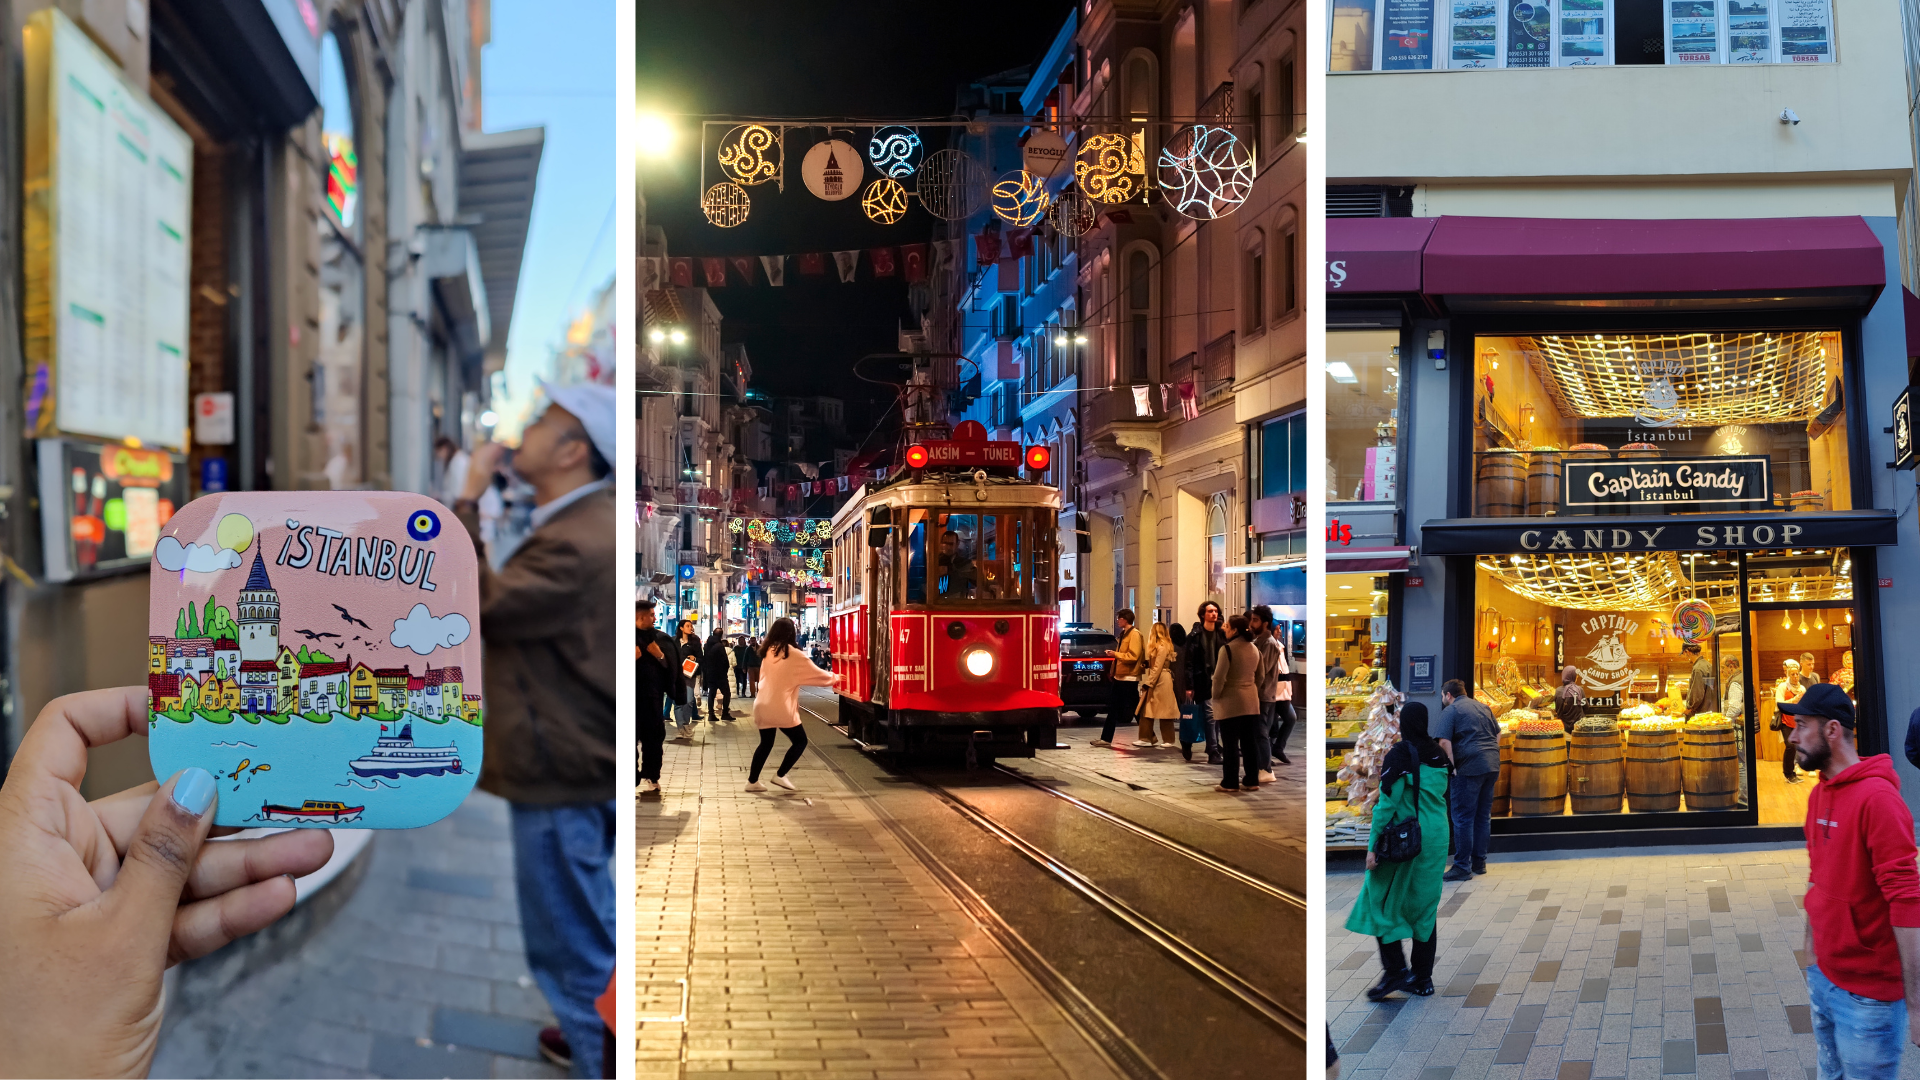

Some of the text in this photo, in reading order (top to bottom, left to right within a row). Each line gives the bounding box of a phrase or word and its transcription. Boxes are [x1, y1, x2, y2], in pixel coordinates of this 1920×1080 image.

[1325, 260, 1347, 288] Ş
[1634, 359, 1688, 377] CAPTAIN
[967, 421, 973, 438] 1
[1627, 429, 1692, 442] İstanbul
[1715, 425, 1747, 437] CAPTAIN
[928, 443, 960, 460] AKSİM
[982, 444, 1015, 461] TÜNEL
[1588, 465, 1745, 497] Captain Candy
[1640, 489, 1694, 501] İstanbul
[1520, 524, 1803, 550] CANDY SHOP
[1581, 614, 1639, 636] CAPTAIN
[900, 628, 911, 644] 47
[1044, 628, 1055, 643] 47
[1077, 674, 1101, 682] POLİS
[1588, 667, 1629, 680] CANDY SHOP
[1573, 692, 1641, 706] İstanbul
